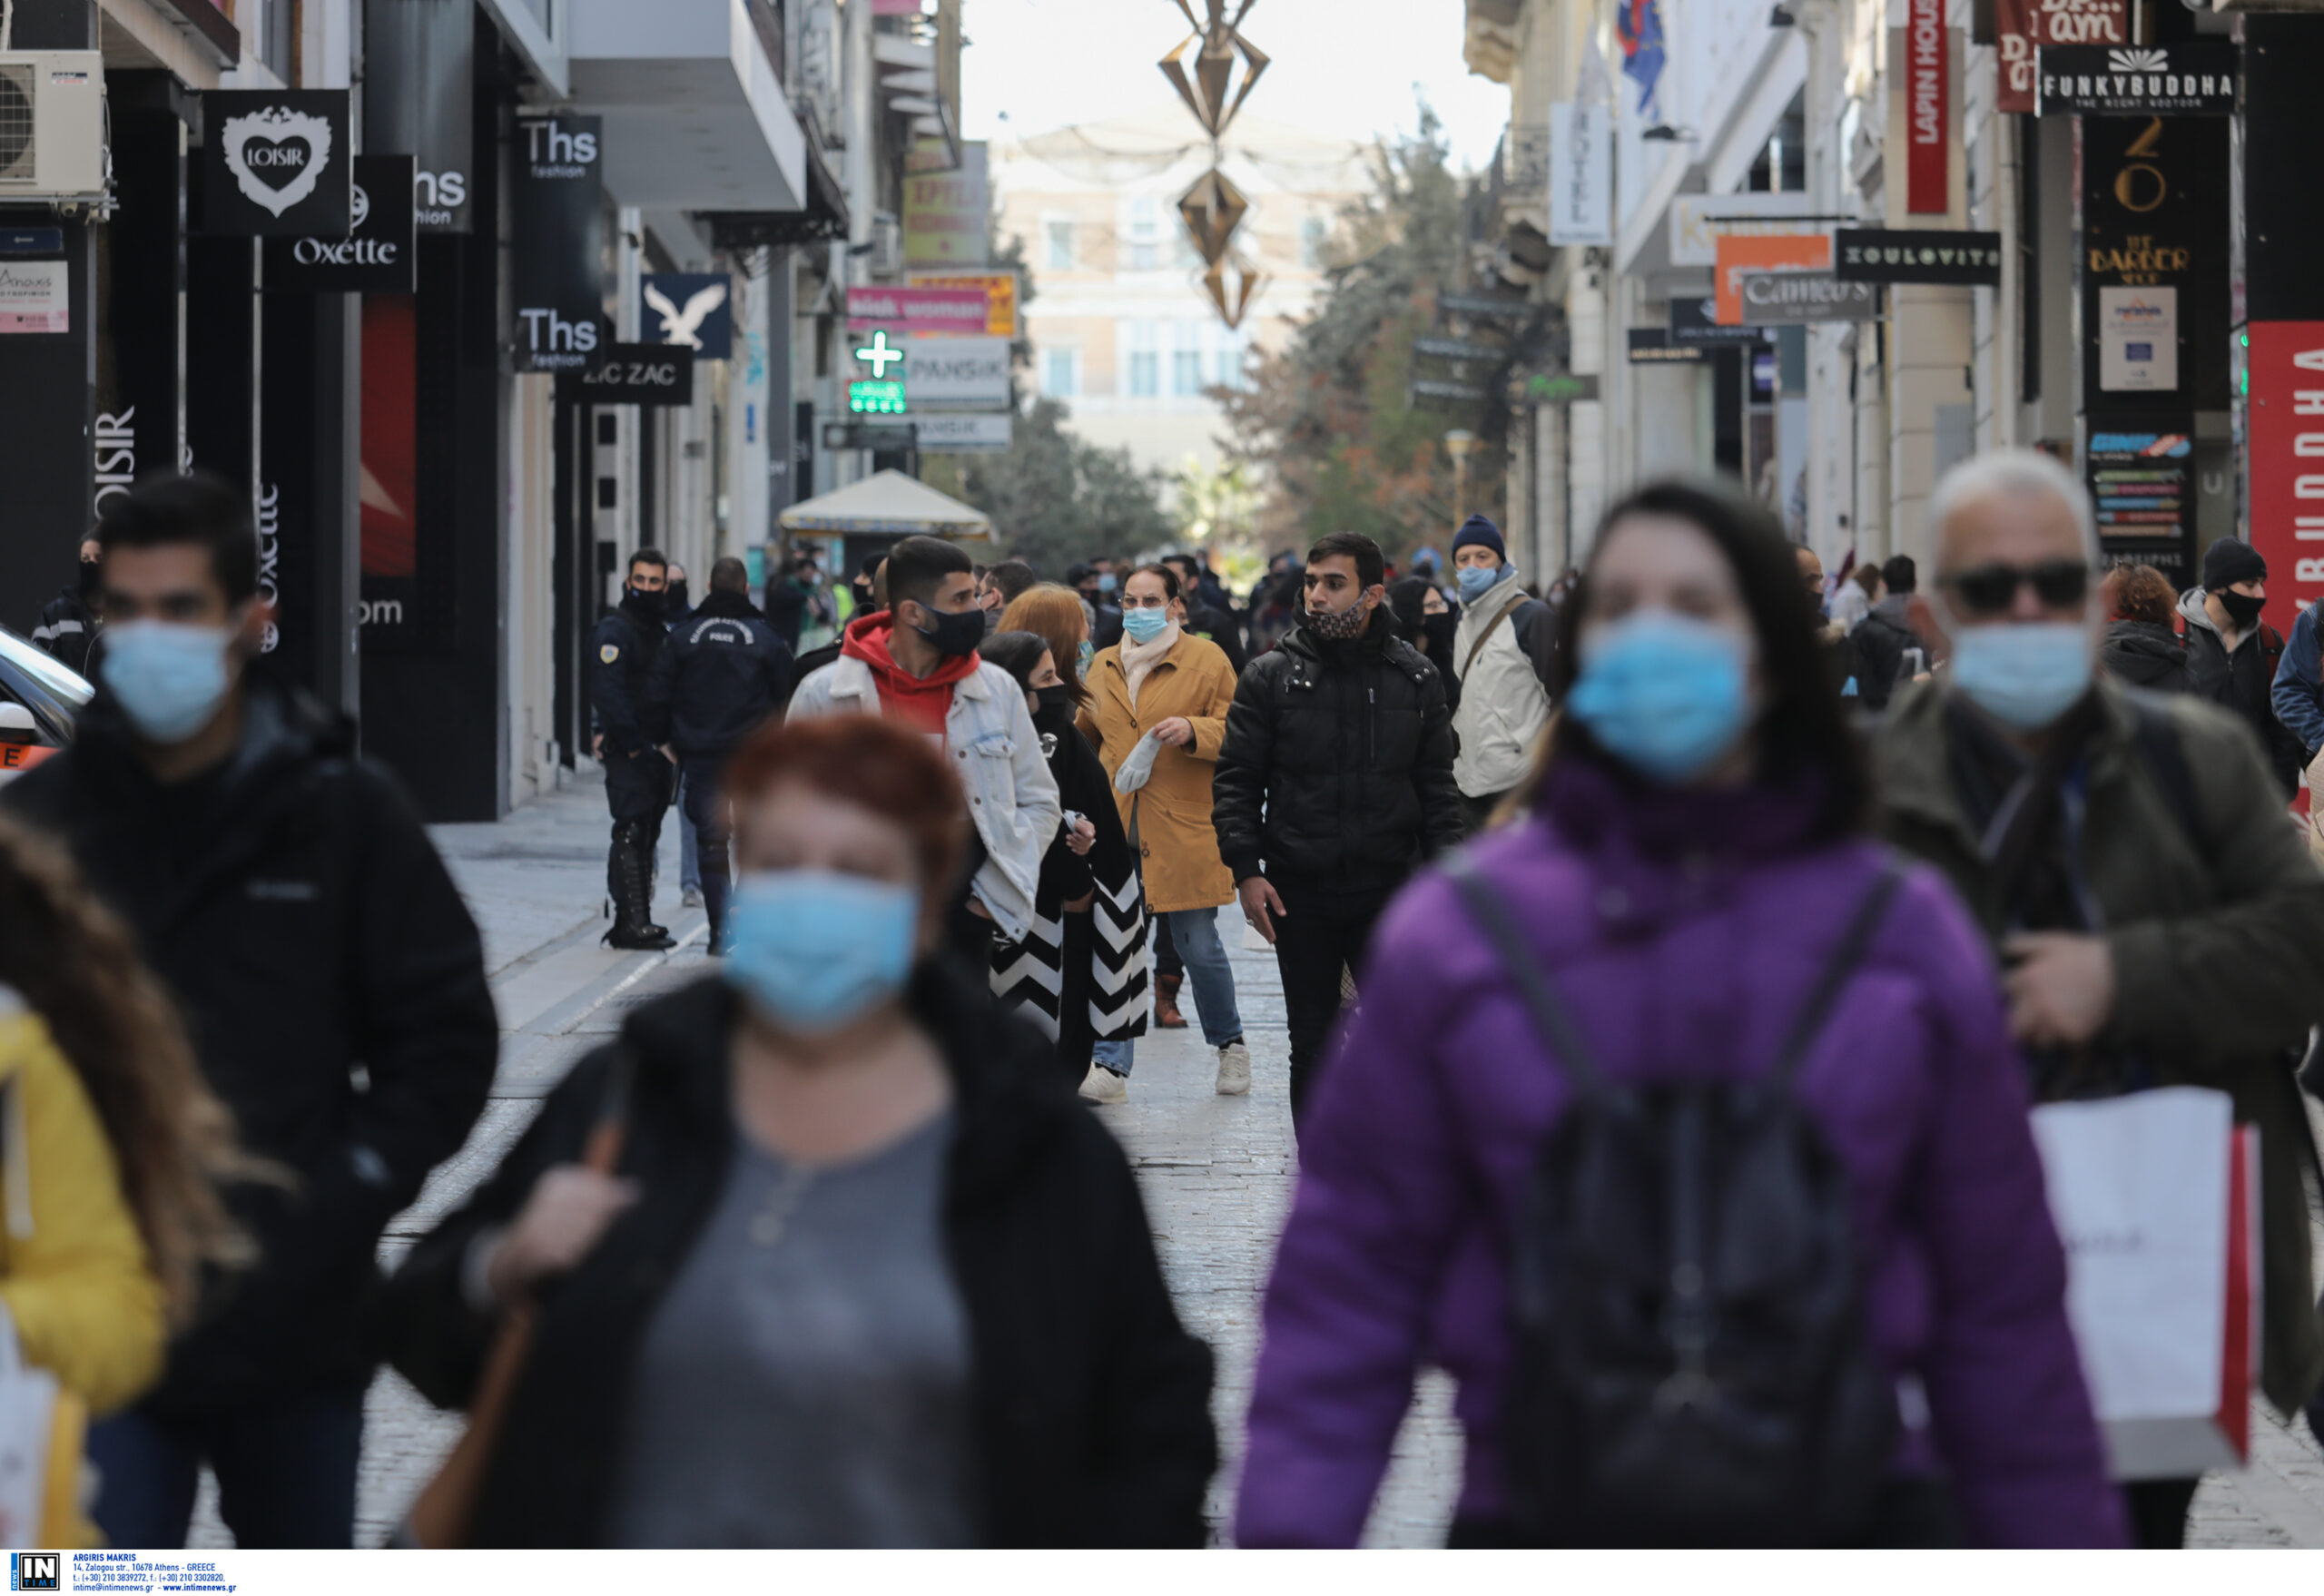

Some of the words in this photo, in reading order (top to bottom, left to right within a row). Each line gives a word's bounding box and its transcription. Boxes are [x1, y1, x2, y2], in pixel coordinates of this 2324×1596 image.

[2043, 75, 2232, 96] FUNKYBUDDHA
[1915, 69, 1938, 143] LAPIN
[520, 121, 597, 163] Ths
[248, 147, 304, 166] LOISIR
[531, 165, 586, 179] fashion
[519, 307, 597, 351] Ths
[532, 353, 586, 367] fashion
[626, 364, 675, 386] ZAC
[94, 405, 134, 521] OISIR
